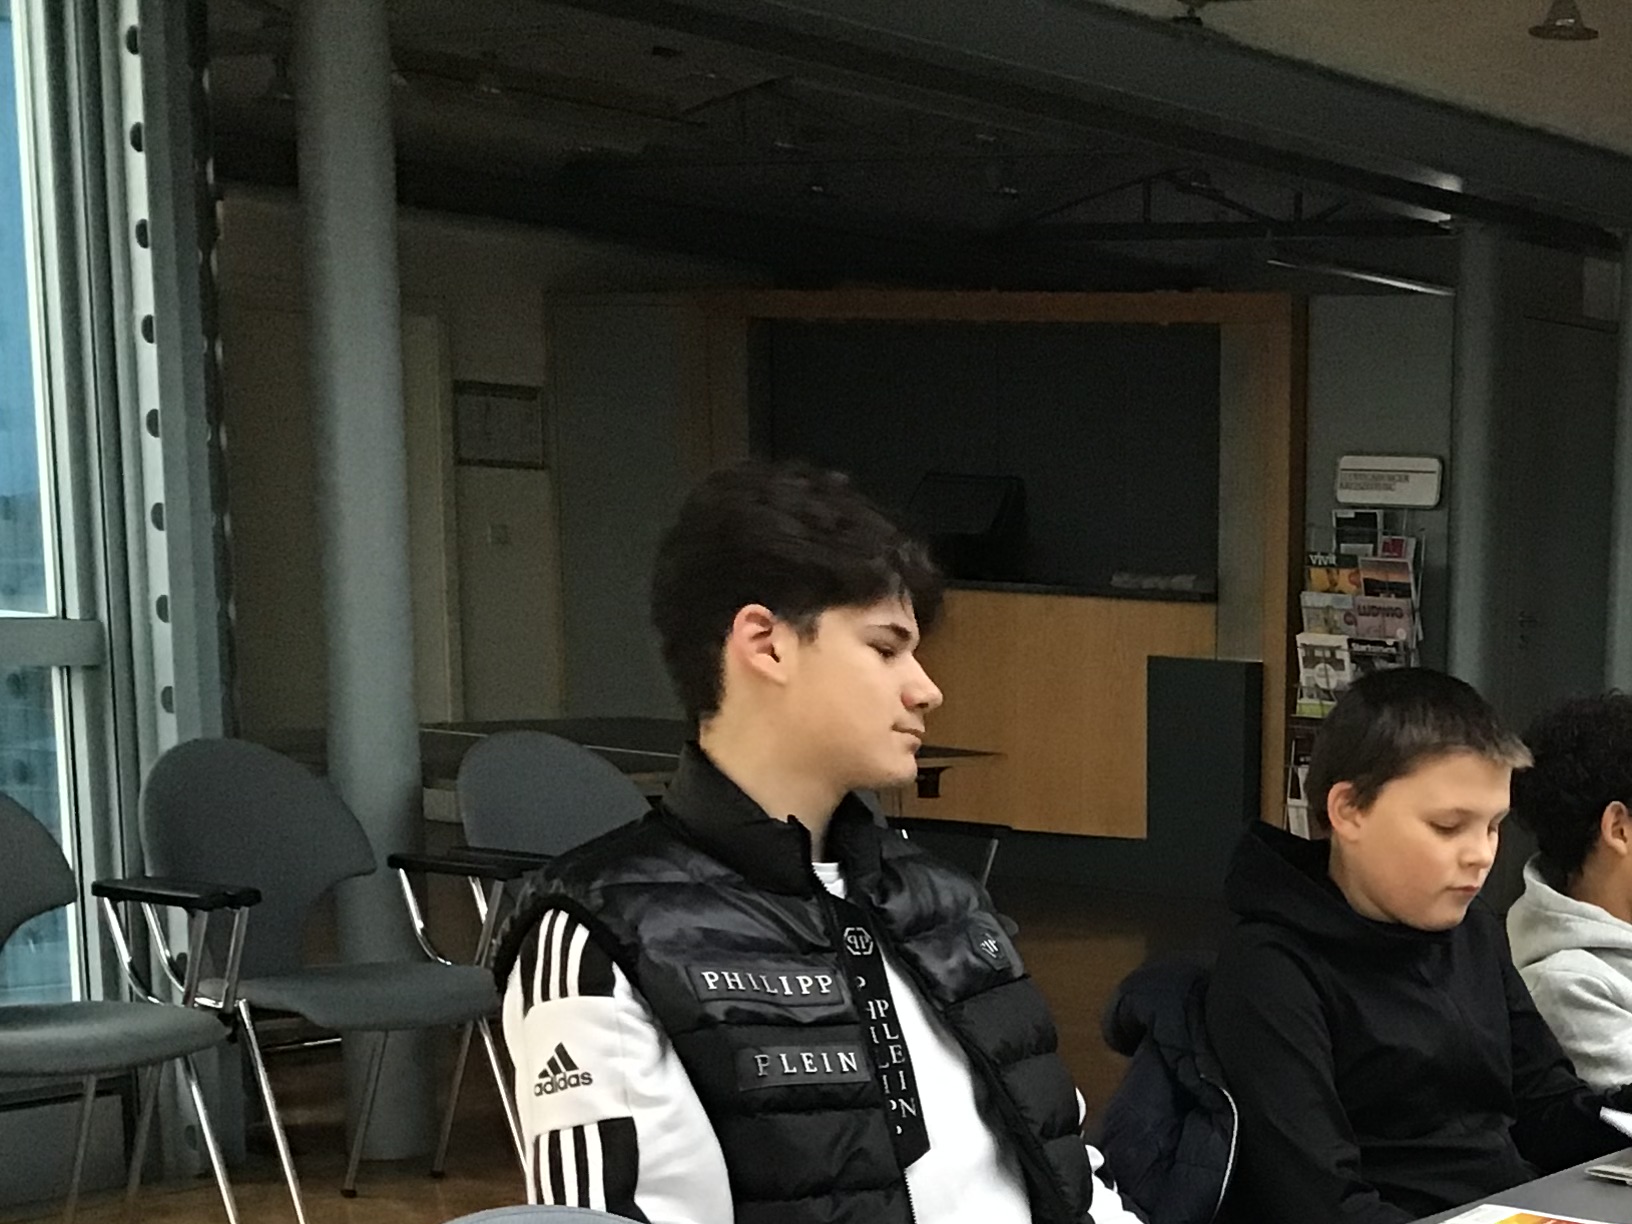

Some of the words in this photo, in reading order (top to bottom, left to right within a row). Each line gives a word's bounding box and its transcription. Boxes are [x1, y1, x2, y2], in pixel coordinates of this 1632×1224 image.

[701, 971, 833, 996] PHILIPP
[754, 1052, 859, 1077] PLEIN
[534, 1071, 593, 1097] adidas
